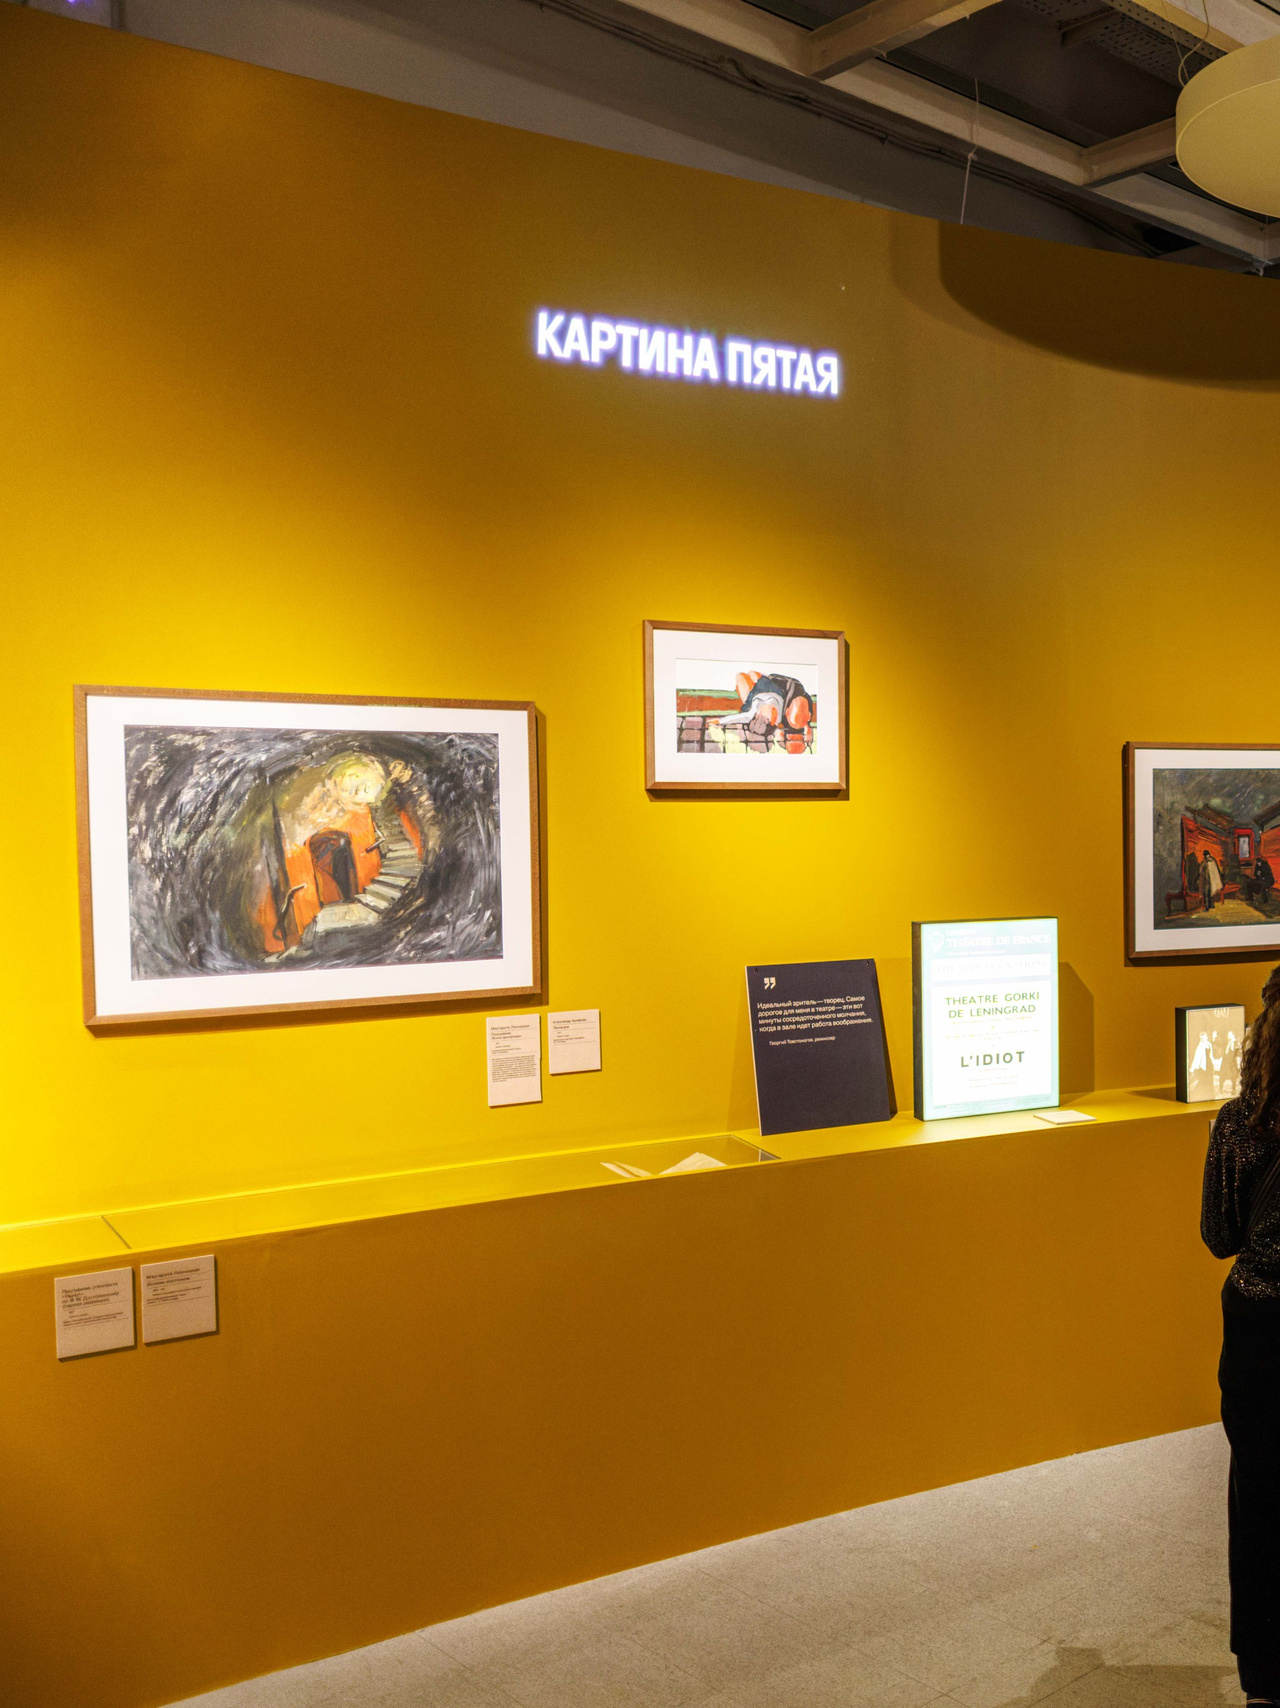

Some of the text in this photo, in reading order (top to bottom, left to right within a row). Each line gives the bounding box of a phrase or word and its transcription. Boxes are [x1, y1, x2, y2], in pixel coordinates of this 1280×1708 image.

[537, 311, 839, 395] КАРТИНА ПЯТАЯ
[757, 1000, 792, 1009] Идеальный
[793, 999, 817, 1007] зритель
[846, 995, 865, 1003] Самое
[944, 991, 1040, 1006] THEATRE GORKI
[758, 1010, 783, 1018] дорогое
[783, 1008, 795, 1016] для
[816, 1005, 836, 1013] театре
[948, 1004, 1036, 1019] DE LENINGRAD
[758, 1017, 782, 1025] минуты
[782, 1013, 837, 1023] сосредоточенного
[759, 1025, 776, 1033] когда
[811, 1020, 832, 1029] работа
[960, 1051, 1025, 1067] L'IDIOT
